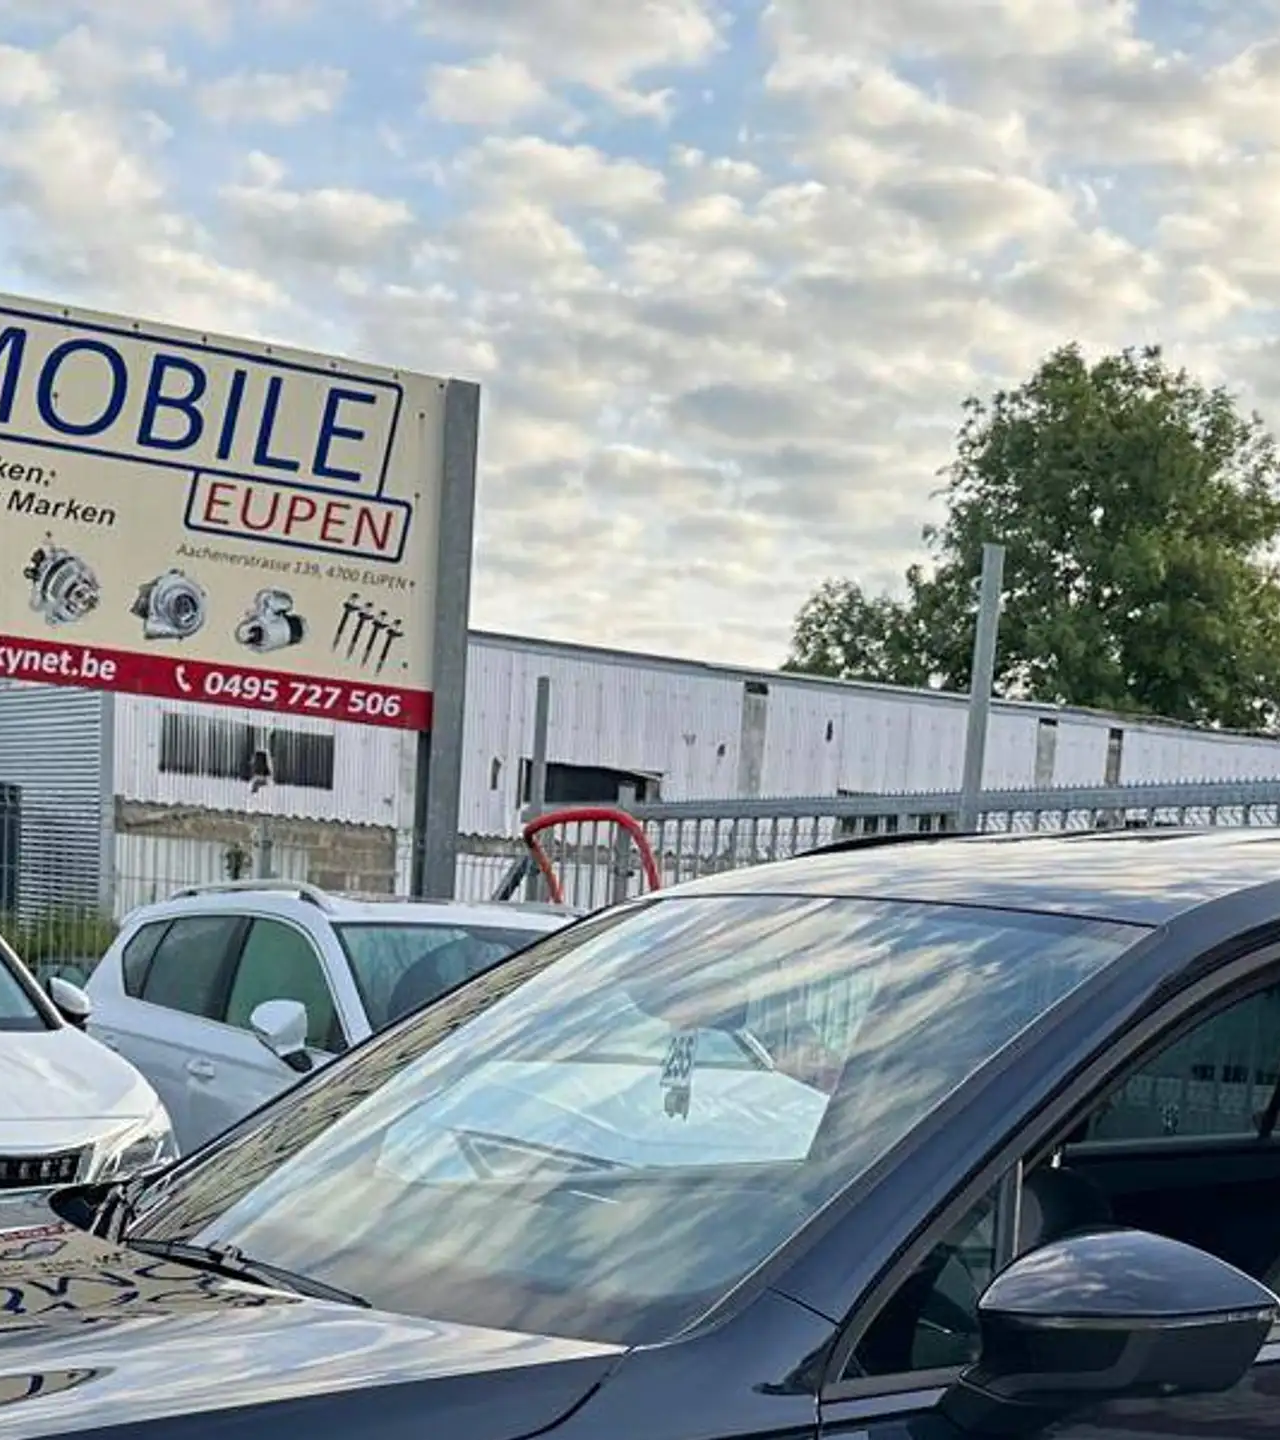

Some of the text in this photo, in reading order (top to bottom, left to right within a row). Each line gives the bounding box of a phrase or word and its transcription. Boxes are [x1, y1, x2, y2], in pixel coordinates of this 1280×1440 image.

[7, 489, 116, 526] Marken
[203, 482, 394, 550] EUPEN
[326, 567, 360, 583] 4700
[361, 572, 408, 590] EUPEN
[204, 671, 402, 717] 0495 727 506
